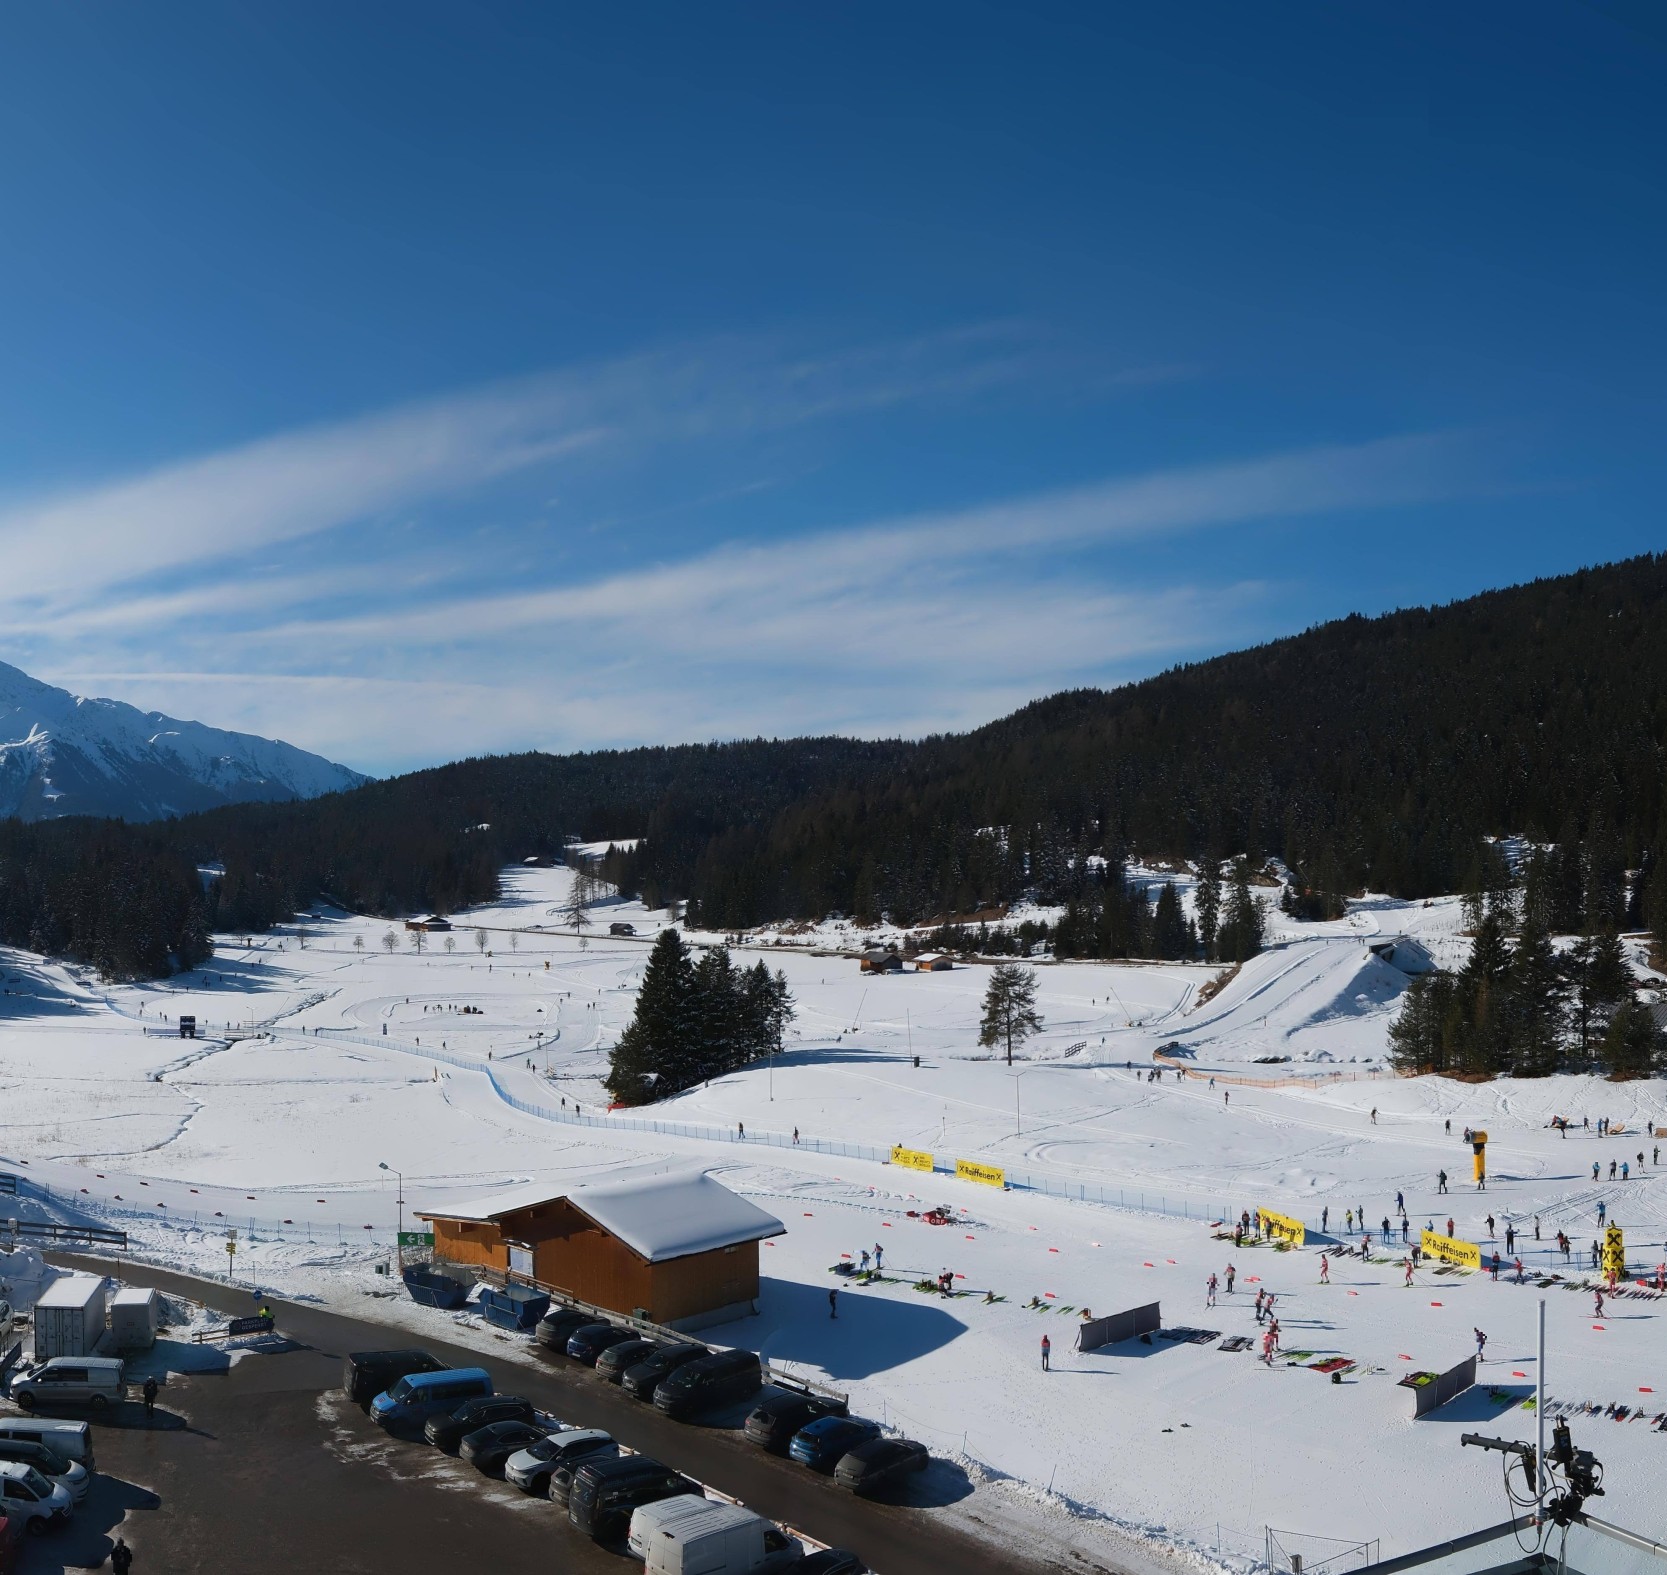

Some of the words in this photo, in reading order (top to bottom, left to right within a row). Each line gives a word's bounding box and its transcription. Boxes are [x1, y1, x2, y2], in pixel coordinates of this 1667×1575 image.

[965, 1166, 995, 1181] Raiffeisen
[931, 1217, 945, 1225] ORF
[1433, 1240, 1469, 1259] Raiffeisen
